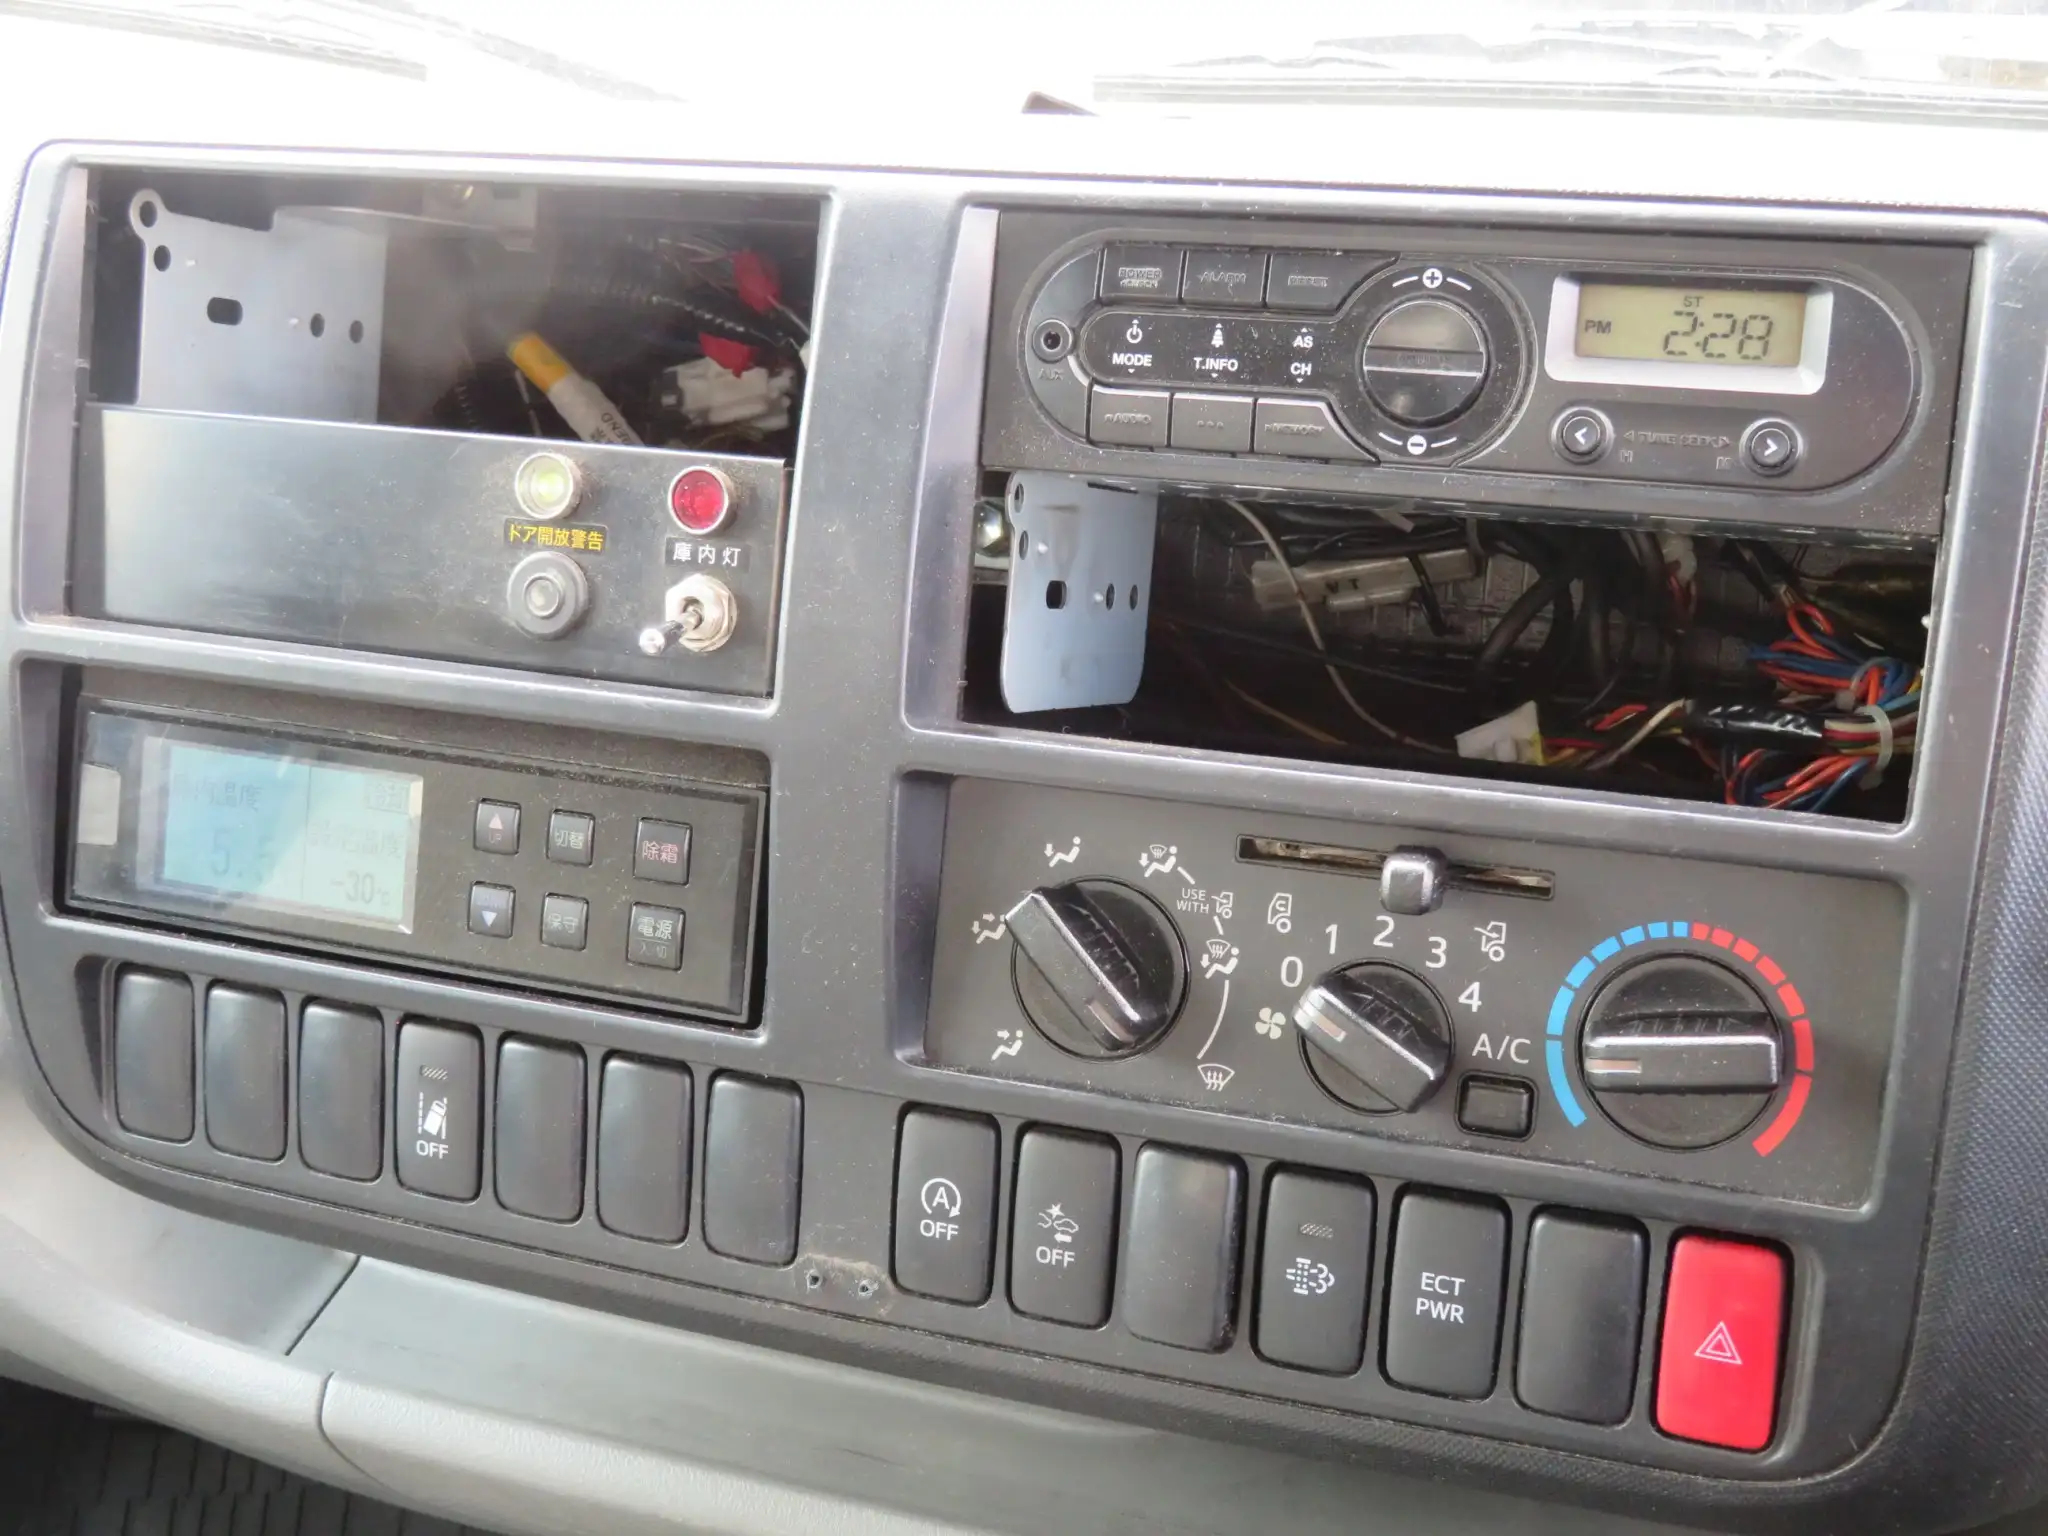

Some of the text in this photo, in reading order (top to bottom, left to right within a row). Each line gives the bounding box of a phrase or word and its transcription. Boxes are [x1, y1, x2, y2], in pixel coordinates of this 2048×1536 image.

[1683, 295, 1704, 308] ST
[1292, 335, 1314, 349] AS
[1584, 310, 1774, 361] PM 2:28
[1112, 352, 1153, 368] MODE
[1193, 356, 1239, 373] T.INFO
[1290, 362, 1312, 376] CH
[1637, 431, 1677, 445] TUNE
[508, 523, 605, 552] ドア開放警告
[673, 541, 742, 568] 庫内灯
[554, 830, 584, 851] 切替
[642, 839, 679, 865] 除霜
[1182, 888, 1206, 901] USE
[1177, 900, 1210, 914] WITH
[548, 913, 579, 935] 保守
[637, 915, 674, 941] 電源
[1372, 915, 1396, 948] 2
[1325, 924, 1338, 954] 1
[1425, 936, 1448, 969] 3
[1280, 956, 1304, 988] 0
[1458, 981, 1483, 1013] 4
[1471, 1033, 1532, 1065] A/C
[415, 1139, 449, 1160] OFF
[932, 1186, 951, 1210] A
[919, 1219, 960, 1242] OFF
[1035, 1246, 1076, 1269] OFF
[1421, 1272, 1467, 1297] ECT
[1416, 1297, 1465, 1325] PWR
